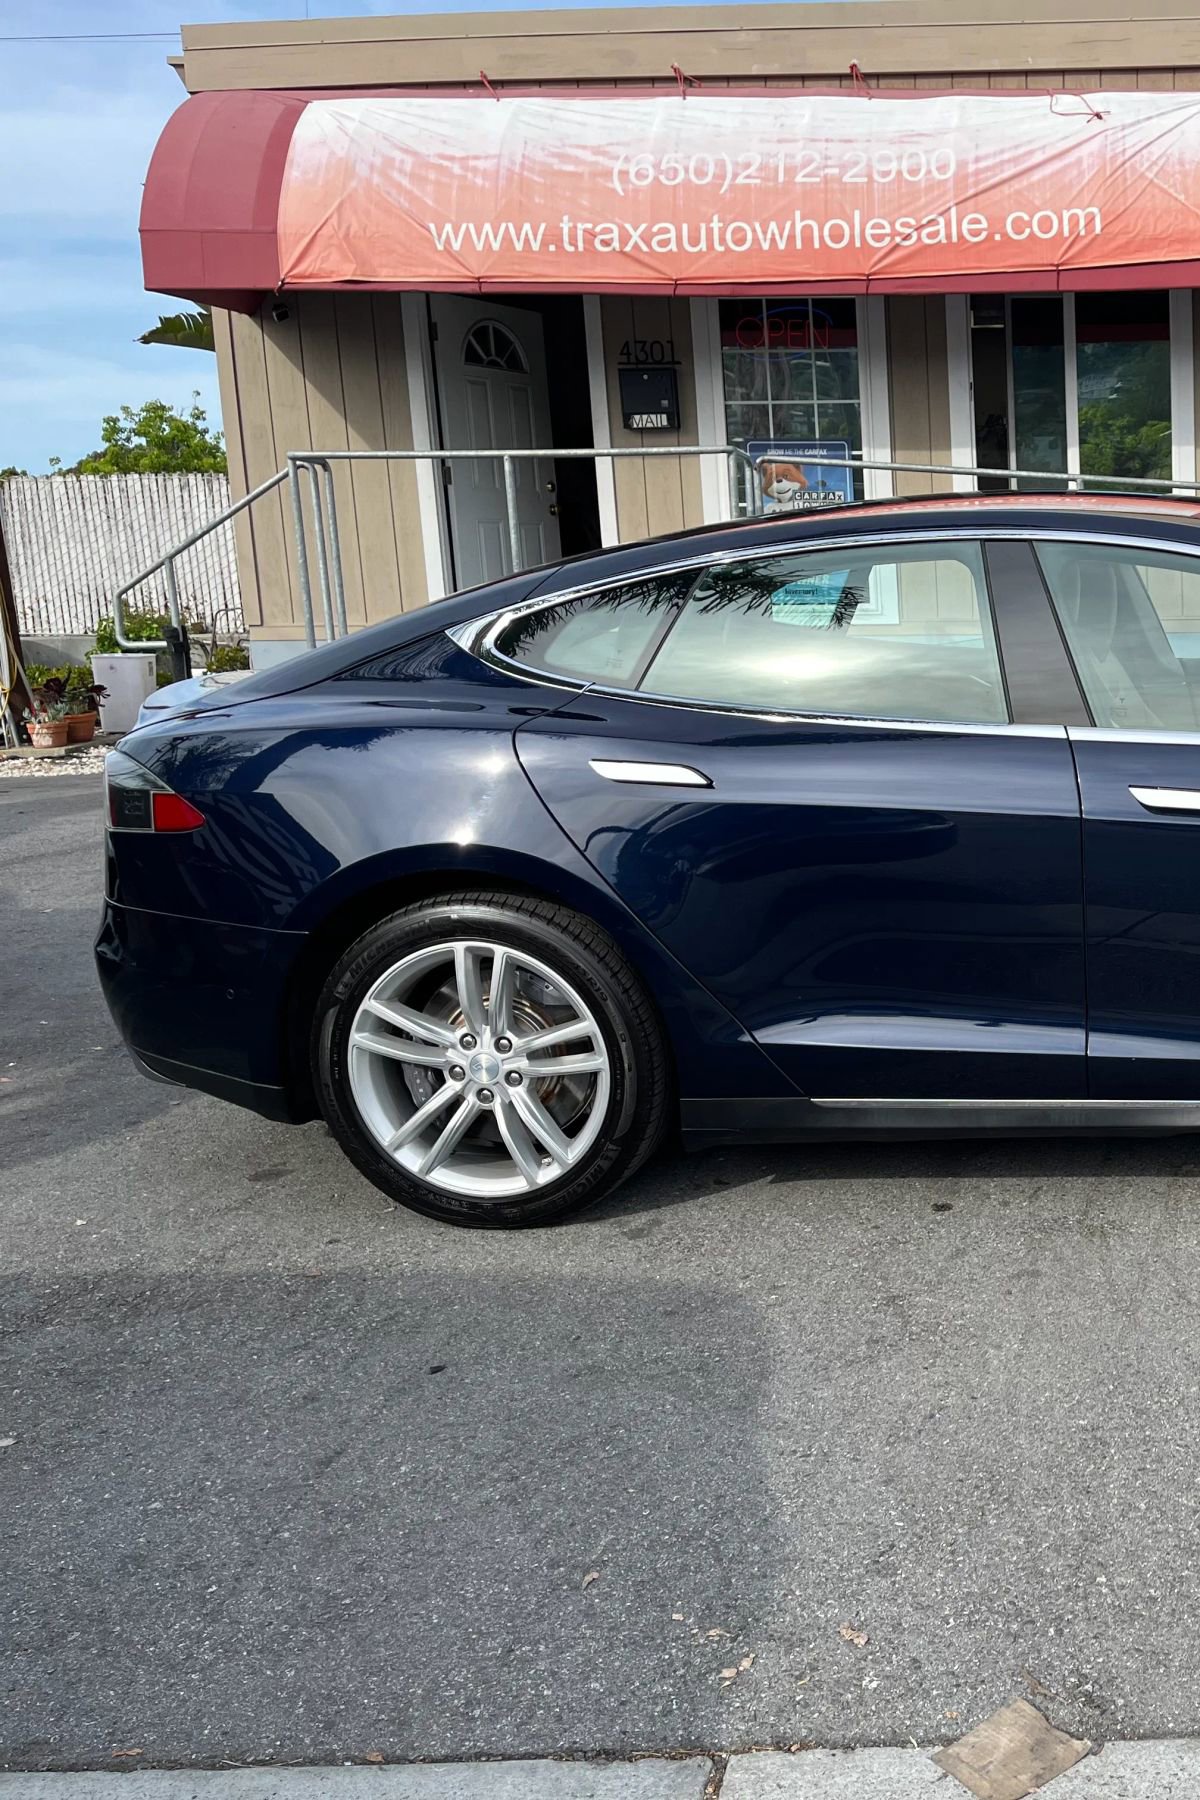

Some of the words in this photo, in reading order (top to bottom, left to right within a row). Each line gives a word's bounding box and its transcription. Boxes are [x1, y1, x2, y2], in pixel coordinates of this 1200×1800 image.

[612, 147, 956, 197] (650)212-2900
[429, 205, 1103, 253] www.traxautowholesale.com
[736, 317, 830, 349] OPEN
[619, 340, 675, 363] 4301
[630, 413, 670, 428] MAIL
[795, 491, 844, 501] CARFAX
